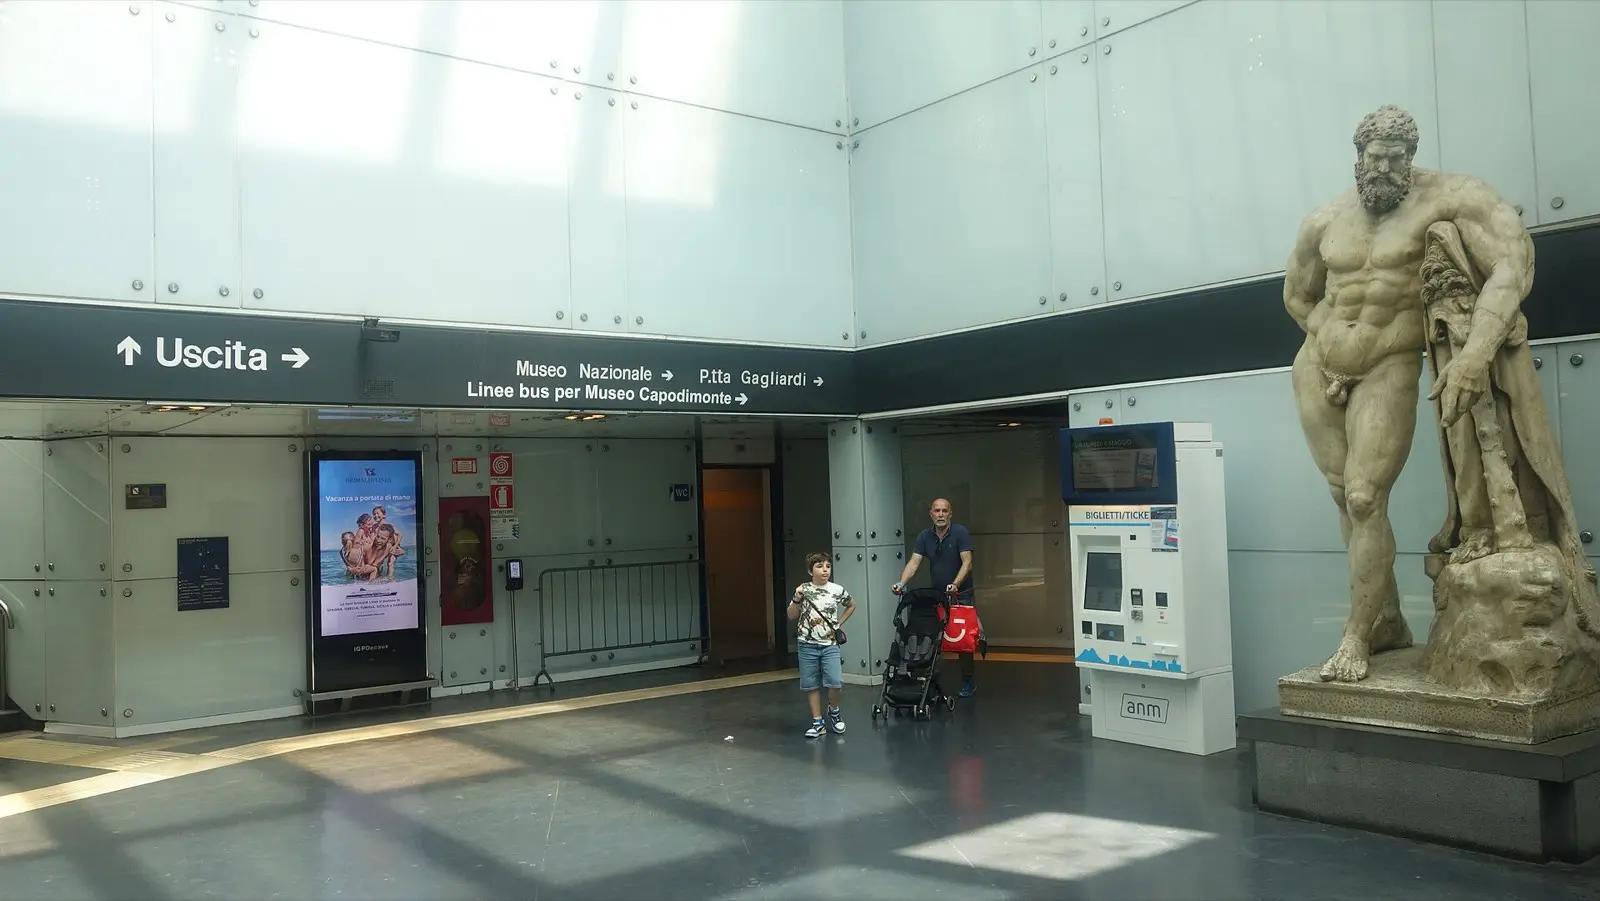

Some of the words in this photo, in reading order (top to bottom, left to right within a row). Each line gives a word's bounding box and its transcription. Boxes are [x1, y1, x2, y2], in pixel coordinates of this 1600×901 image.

[156, 336, 268, 371] Uscita
[516, 360, 567, 378] Museo
[579, 363, 652, 381] Nazionale
[700, 369, 731, 384] P.tta
[741, 370, 807, 388] Gagliardi
[467, 381, 514, 398] Linee
[519, 383, 550, 399] bus
[555, 386, 581, 402] per
[585, 384, 635, 401] Museo
[639, 387, 732, 405] Capodimonte
[675, 488, 689, 497] WC
[1085, 511, 1150, 520] BIGLIETTI/TICKE
[353, 644, 389, 652] IGPDecaux
[1127, 700, 1161, 718] anm
